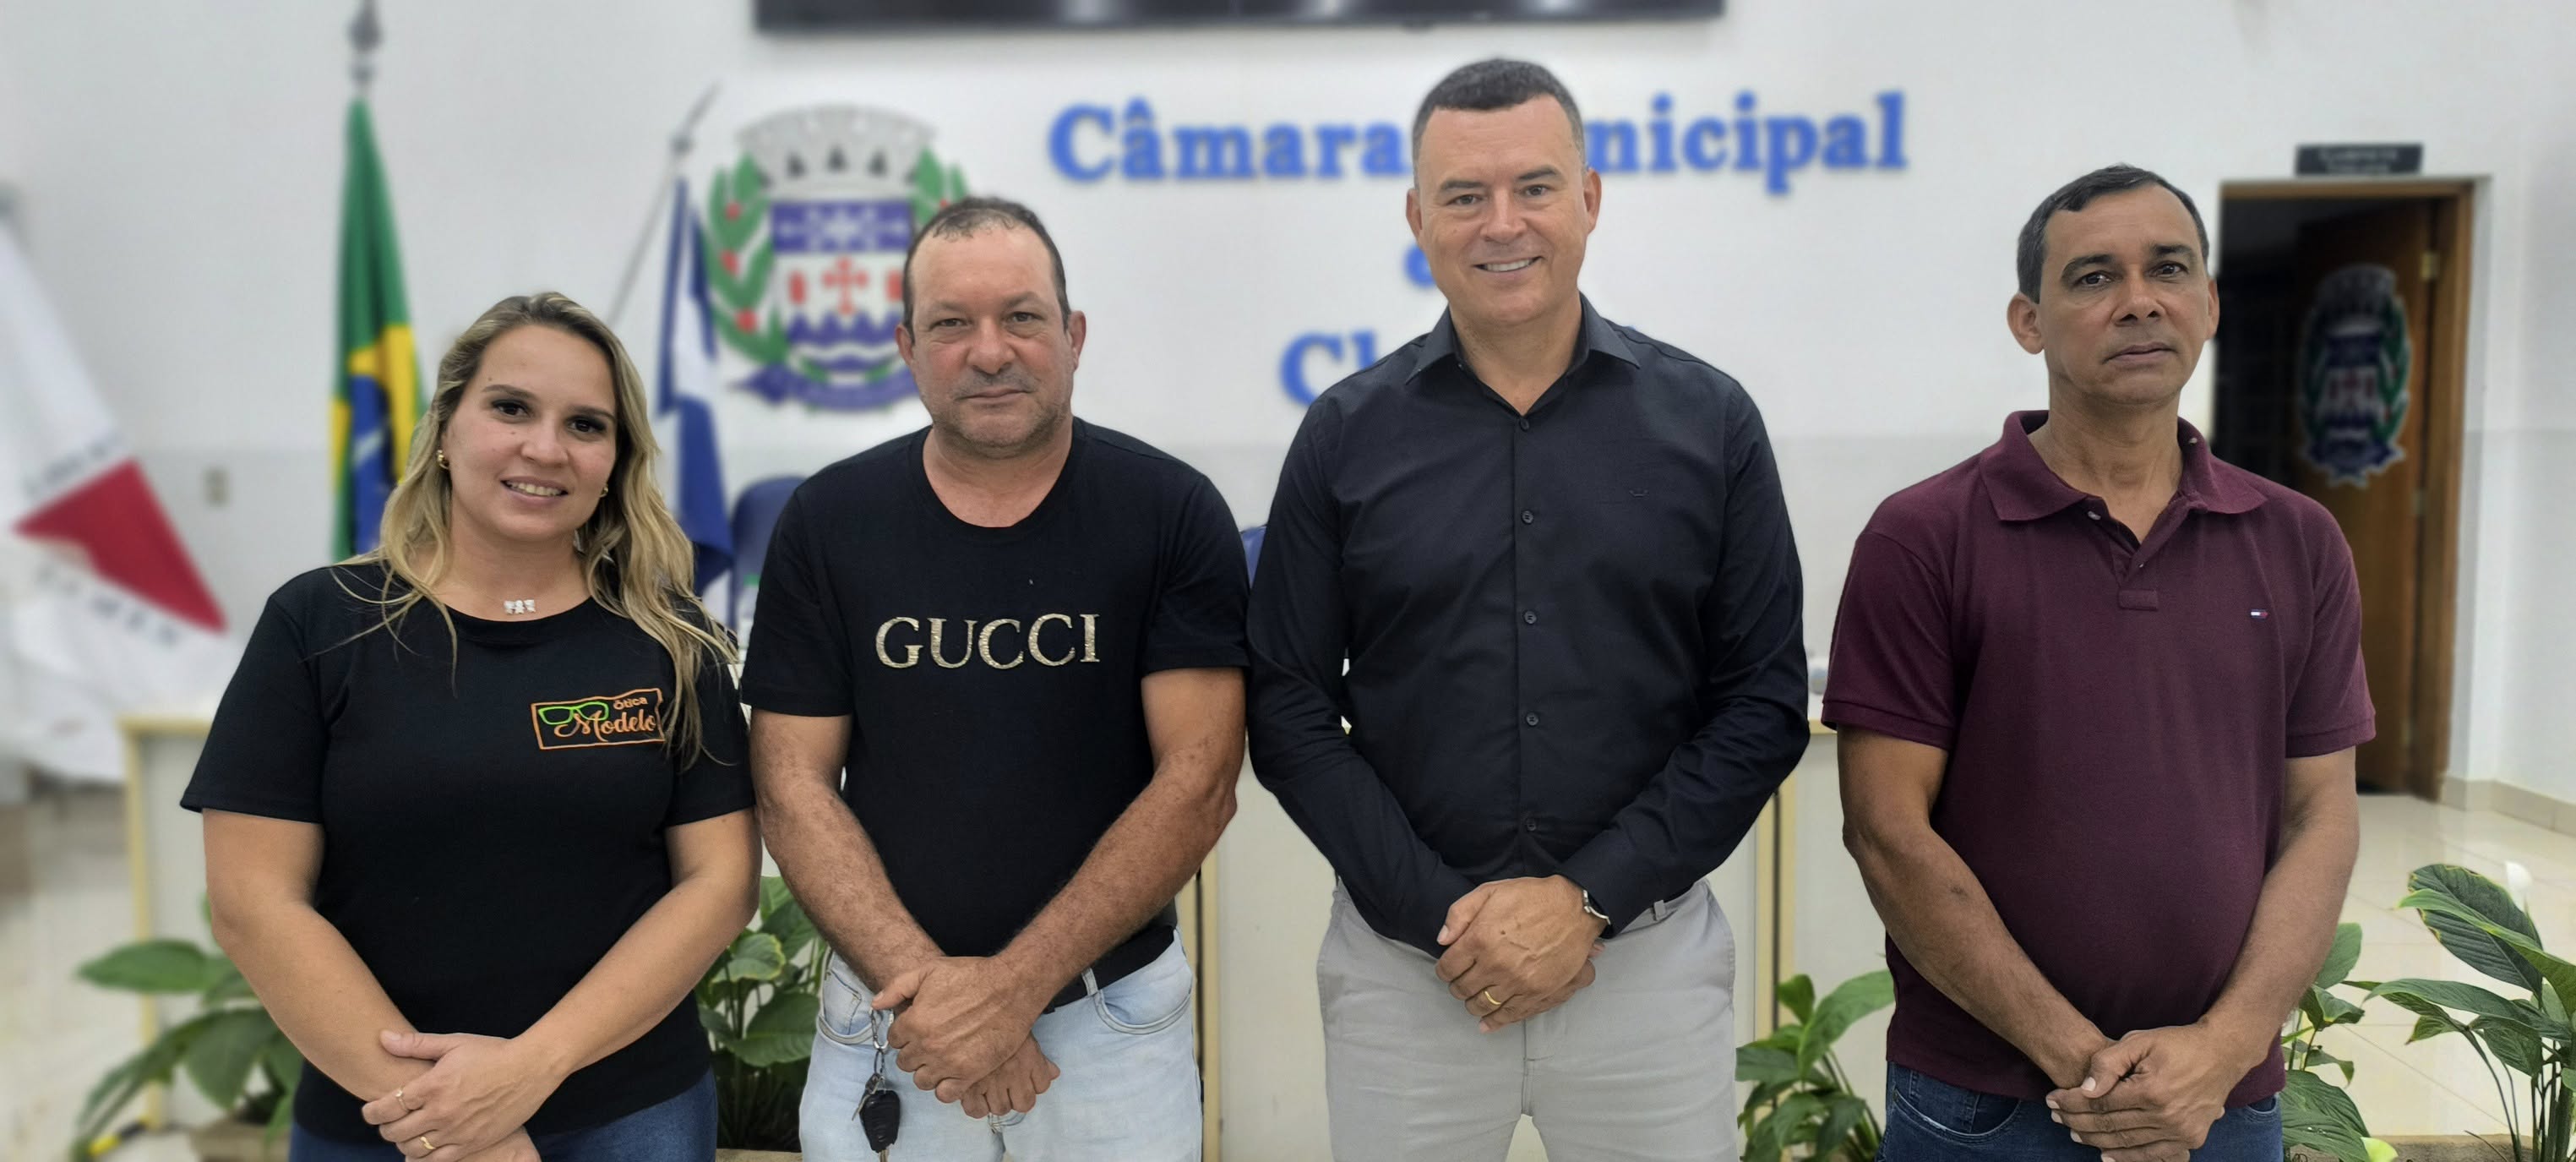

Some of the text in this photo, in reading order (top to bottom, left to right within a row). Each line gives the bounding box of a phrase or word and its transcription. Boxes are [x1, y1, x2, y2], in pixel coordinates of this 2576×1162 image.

[1047, 91, 1908, 195] Câmara nicipal
[875, 613, 1100, 669] GUCCI
[553, 708, 656, 742] Modelo
